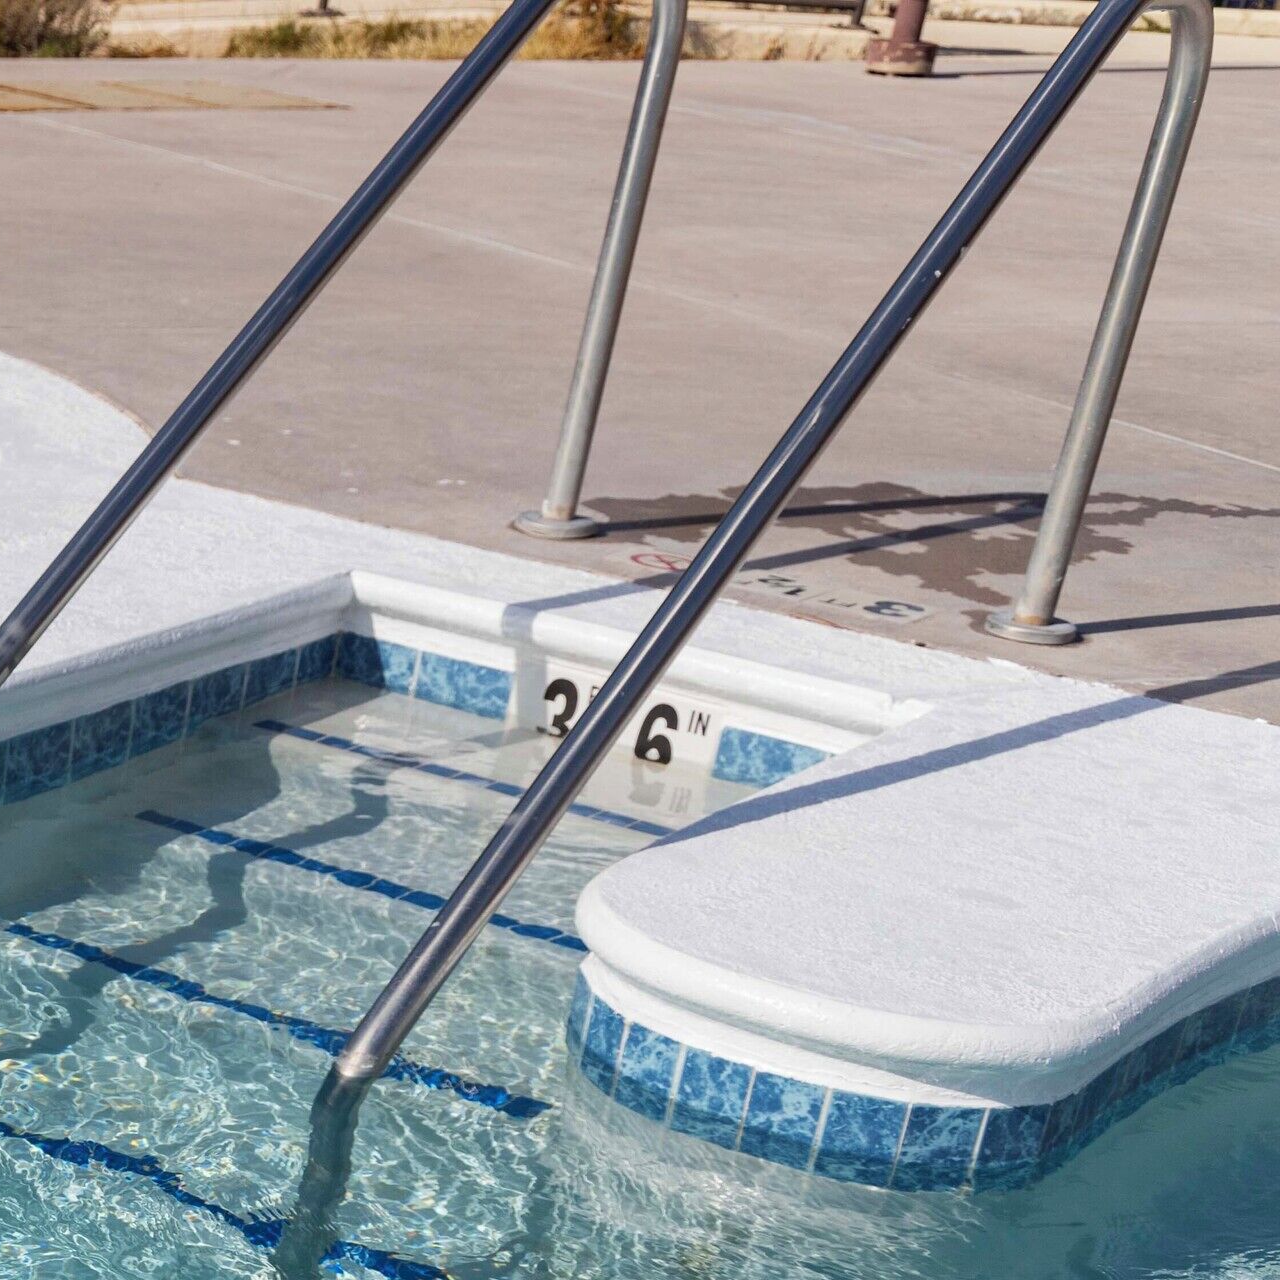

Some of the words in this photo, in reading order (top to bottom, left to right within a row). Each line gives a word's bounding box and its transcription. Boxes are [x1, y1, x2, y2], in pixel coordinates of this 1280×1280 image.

[863, 600, 925, 617] 3
[537, 678, 578, 738] 3
[635, 703, 679, 765] 6
[688, 710, 711, 736] IN
